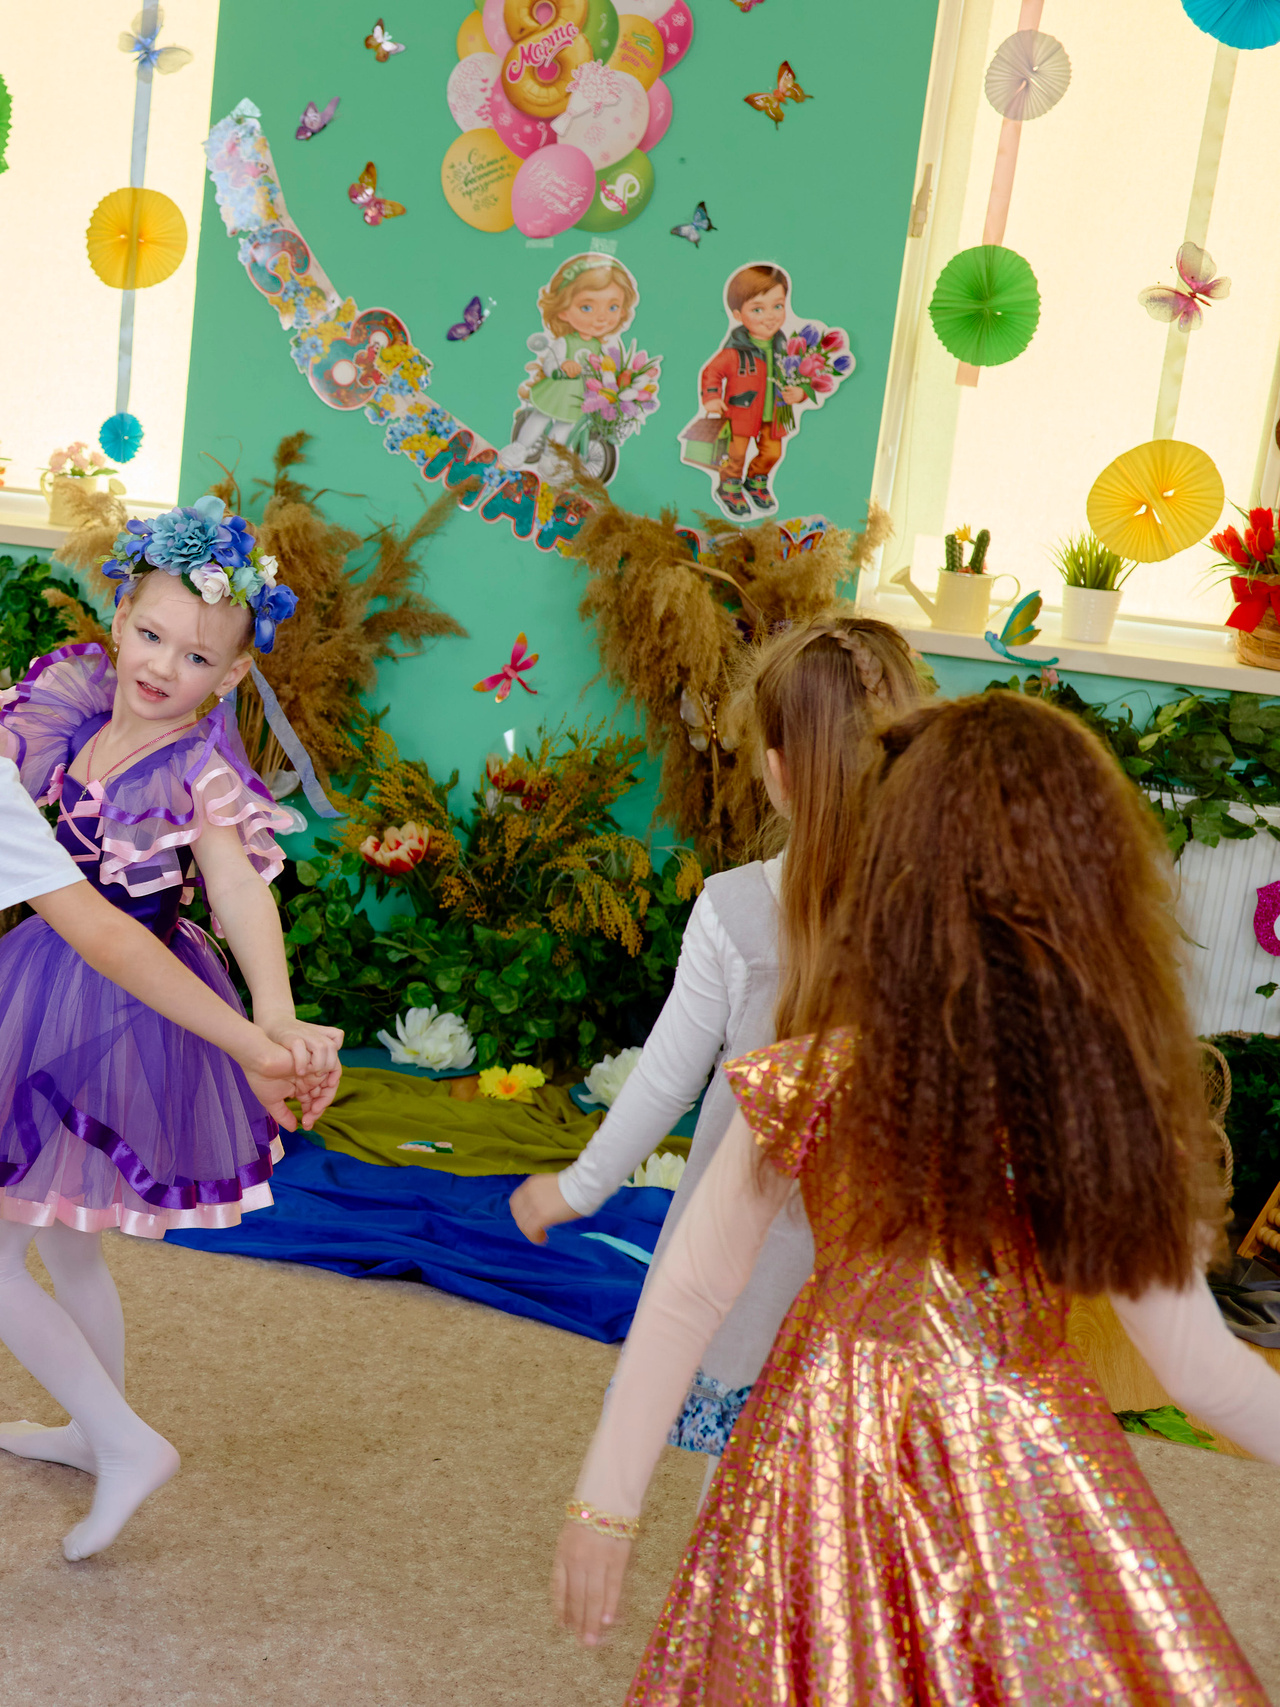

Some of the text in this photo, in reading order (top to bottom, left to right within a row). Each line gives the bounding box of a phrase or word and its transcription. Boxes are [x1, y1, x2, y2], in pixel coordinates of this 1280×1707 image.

[501, 0, 594, 118] 8
[506, 22, 579, 83] Марта
[248, 229, 311, 295] С
[310, 308, 410, 409] 8
